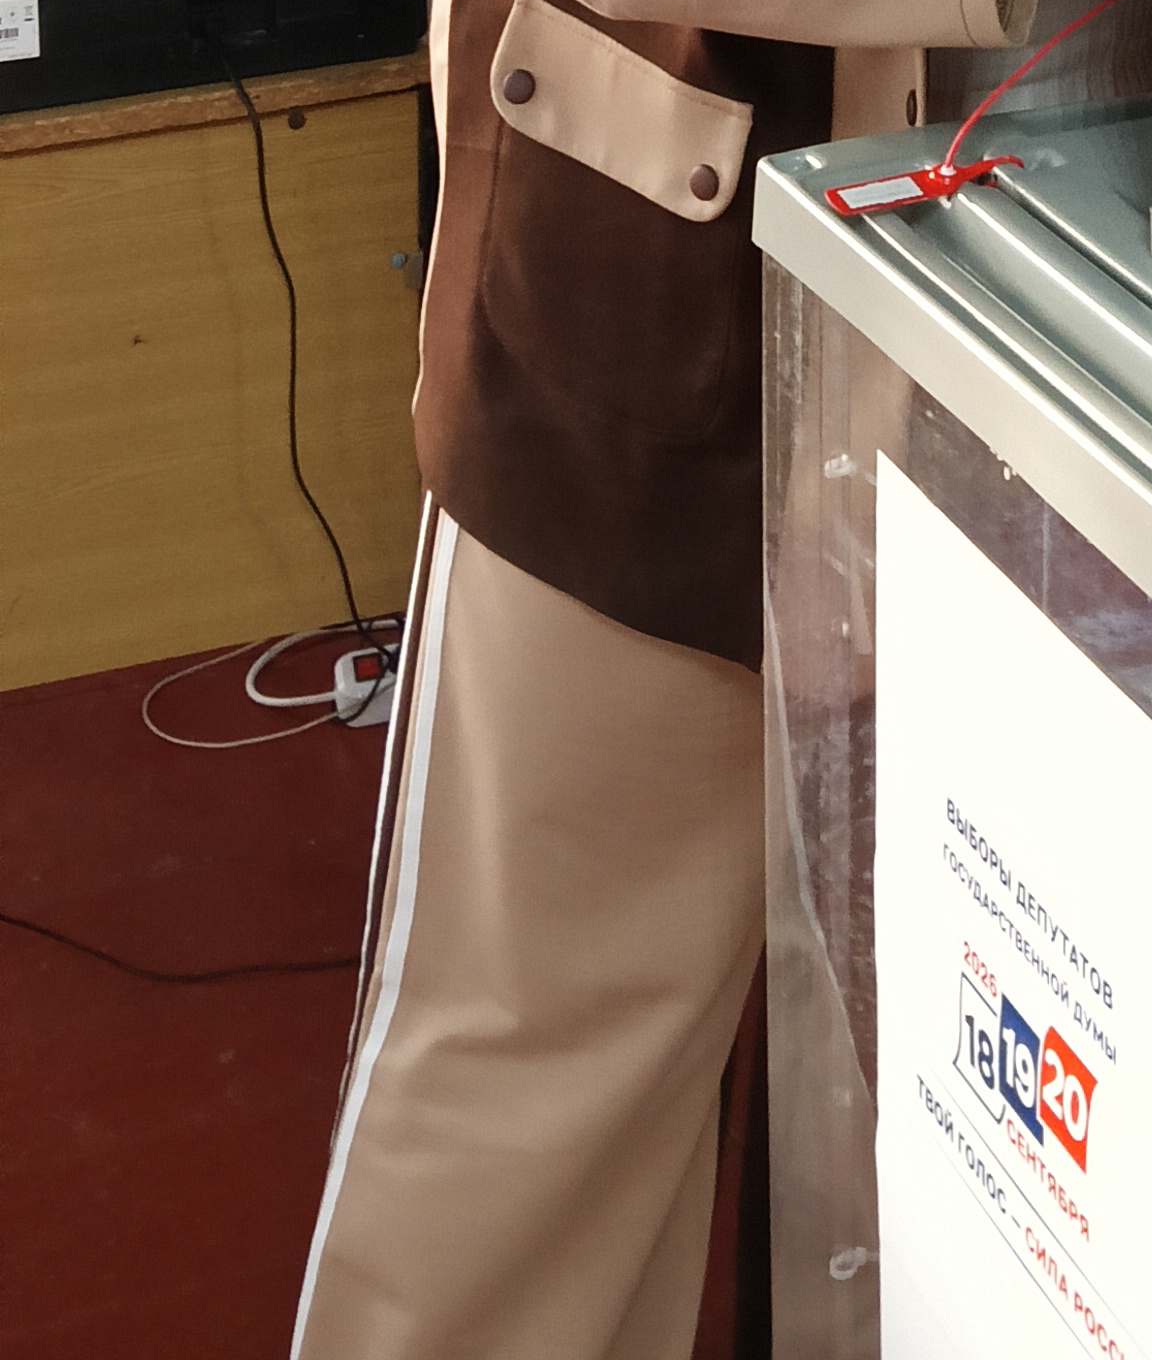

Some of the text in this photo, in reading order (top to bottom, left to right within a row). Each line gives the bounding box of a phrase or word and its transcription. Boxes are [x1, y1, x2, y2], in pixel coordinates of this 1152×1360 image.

[943, 843, 1117, 1066] ГОСУДАРСТВЕННОЙ ДУМЫ
[946, 797, 1114, 1011] ВЫБОРЫ ДЕПУТАТОВ
[962, 940, 999, 999] 2026
[965, 1012, 1089, 1144] 18 19 20
[917, 1072, 954, 1145] ТВОЙ
[957, 1129, 1007, 1215] ГОЛОС
[1025, 1226, 1069, 1301] СИЛА
[1074, 1291, 1126, 1360] РОСС
[1006, 1118, 1090, 1244] СЕНТЯБРЯ
